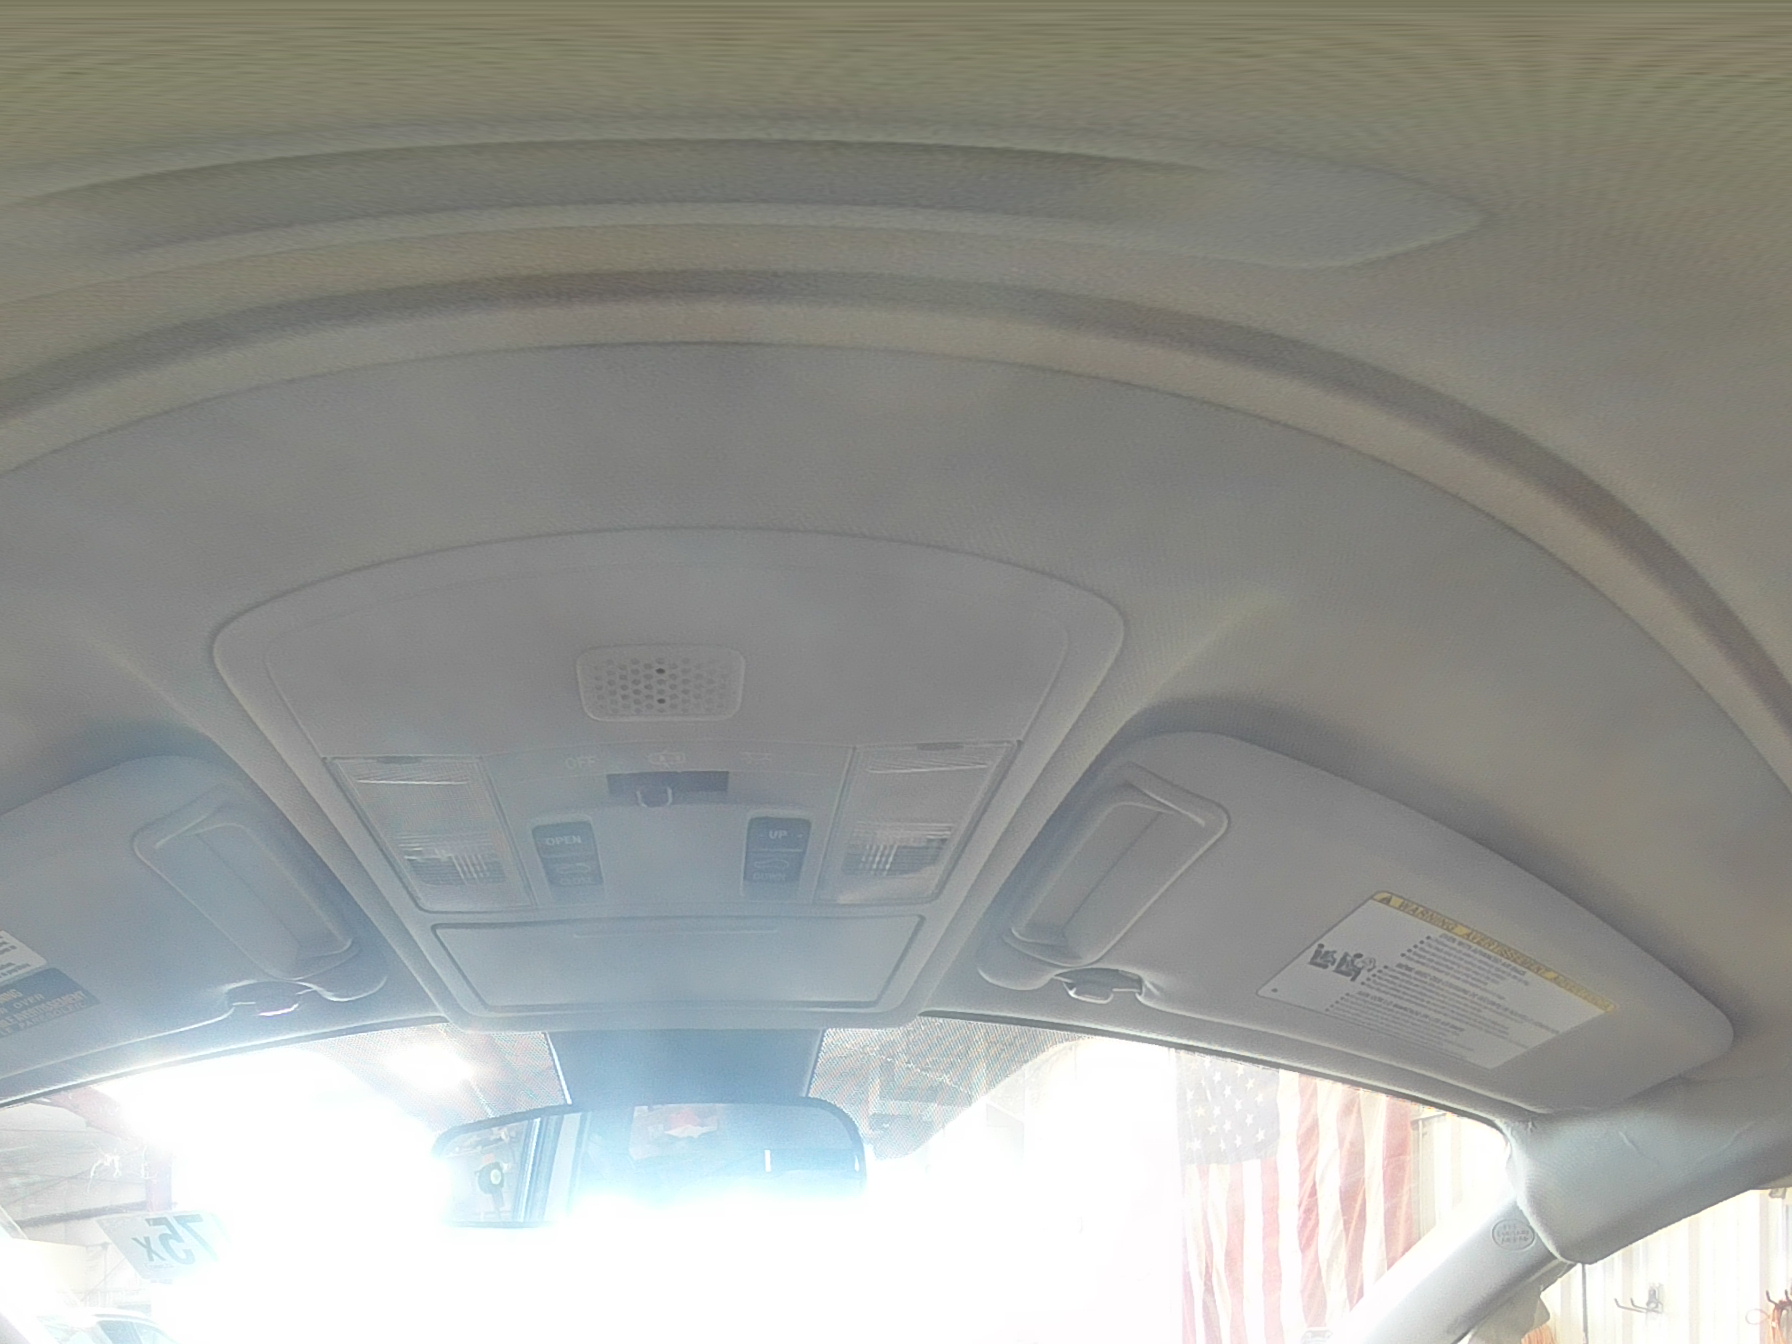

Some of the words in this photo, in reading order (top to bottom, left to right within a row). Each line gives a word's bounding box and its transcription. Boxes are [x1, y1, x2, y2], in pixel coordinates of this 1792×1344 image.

[564, 756, 596, 770] OFF
[545, 834, 583, 846] OPEN
[768, 829, 789, 840] UP
[1398, 901, 1458, 932] WARNING
[13, 993, 45, 1009] OVER
